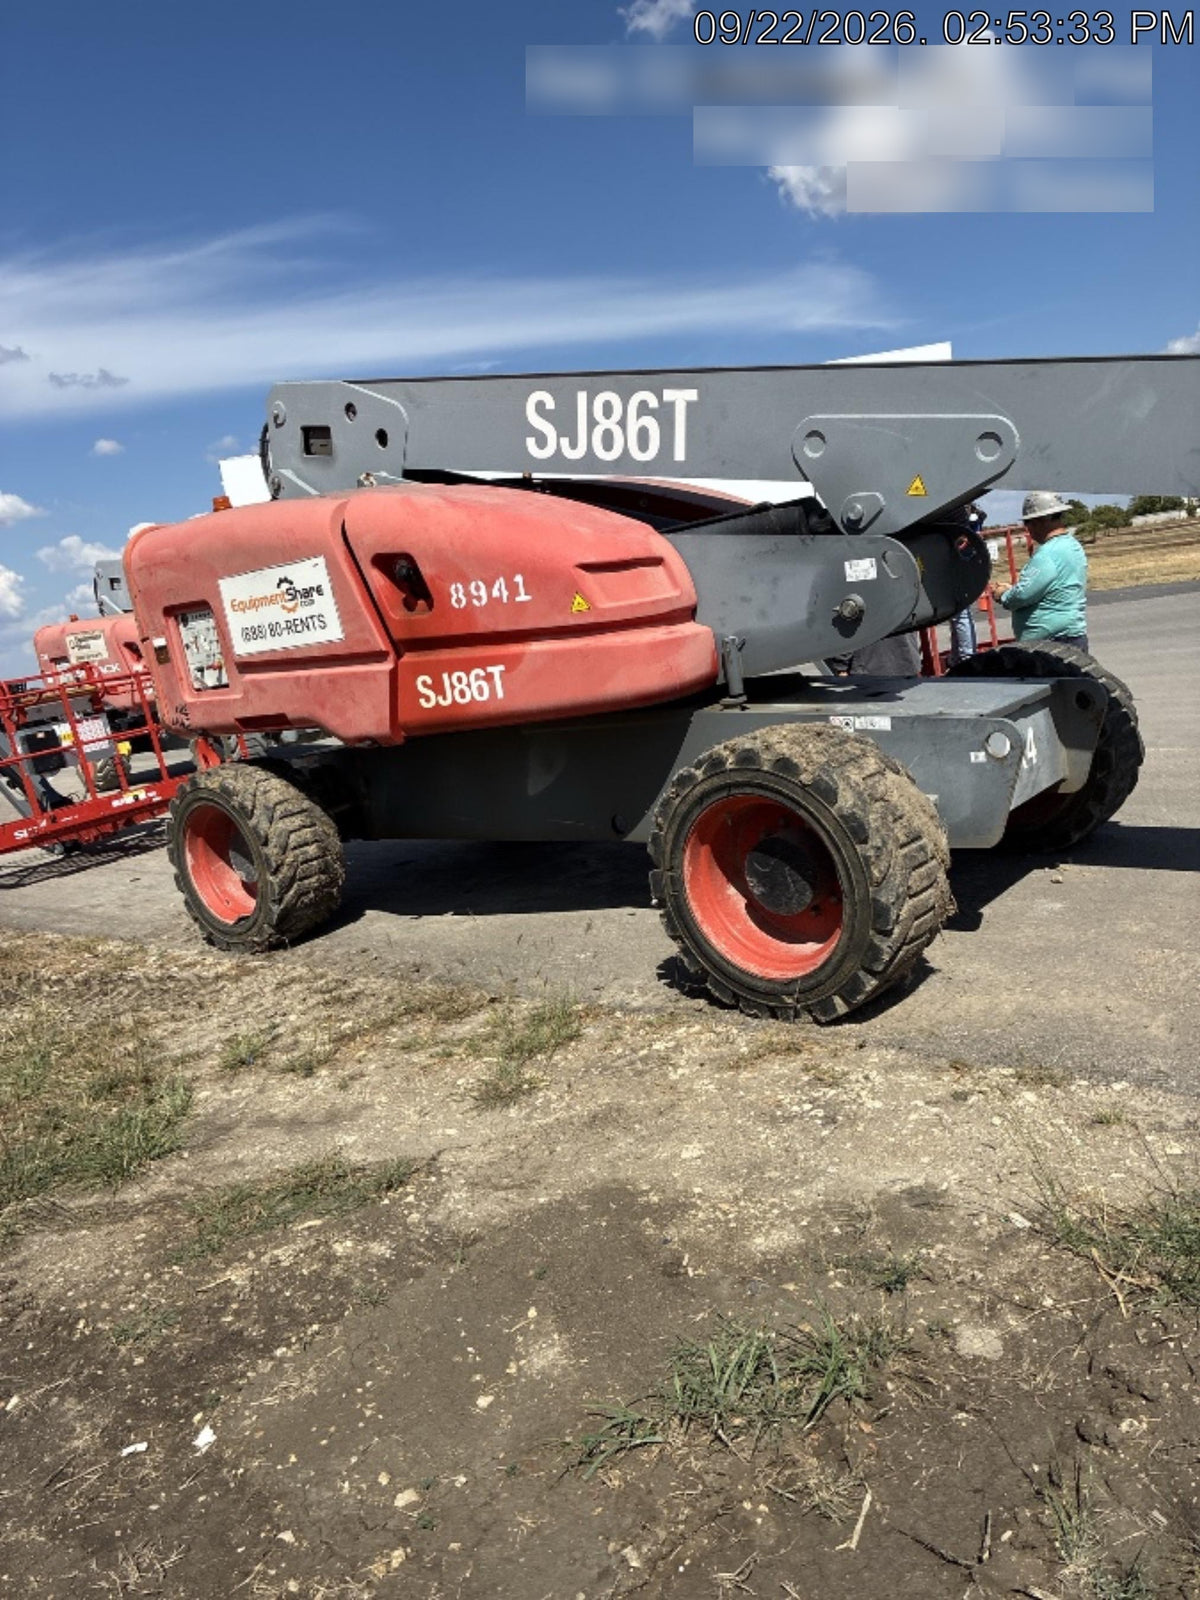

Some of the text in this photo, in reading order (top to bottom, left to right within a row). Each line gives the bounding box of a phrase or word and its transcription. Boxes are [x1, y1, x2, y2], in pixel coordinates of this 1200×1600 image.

[525, 388, 698, 461] SJ86T
[450, 573, 532, 609] 8941
[268, 613, 328, 637] 80-RENTS
[416, 664, 506, 709] SJ86T
